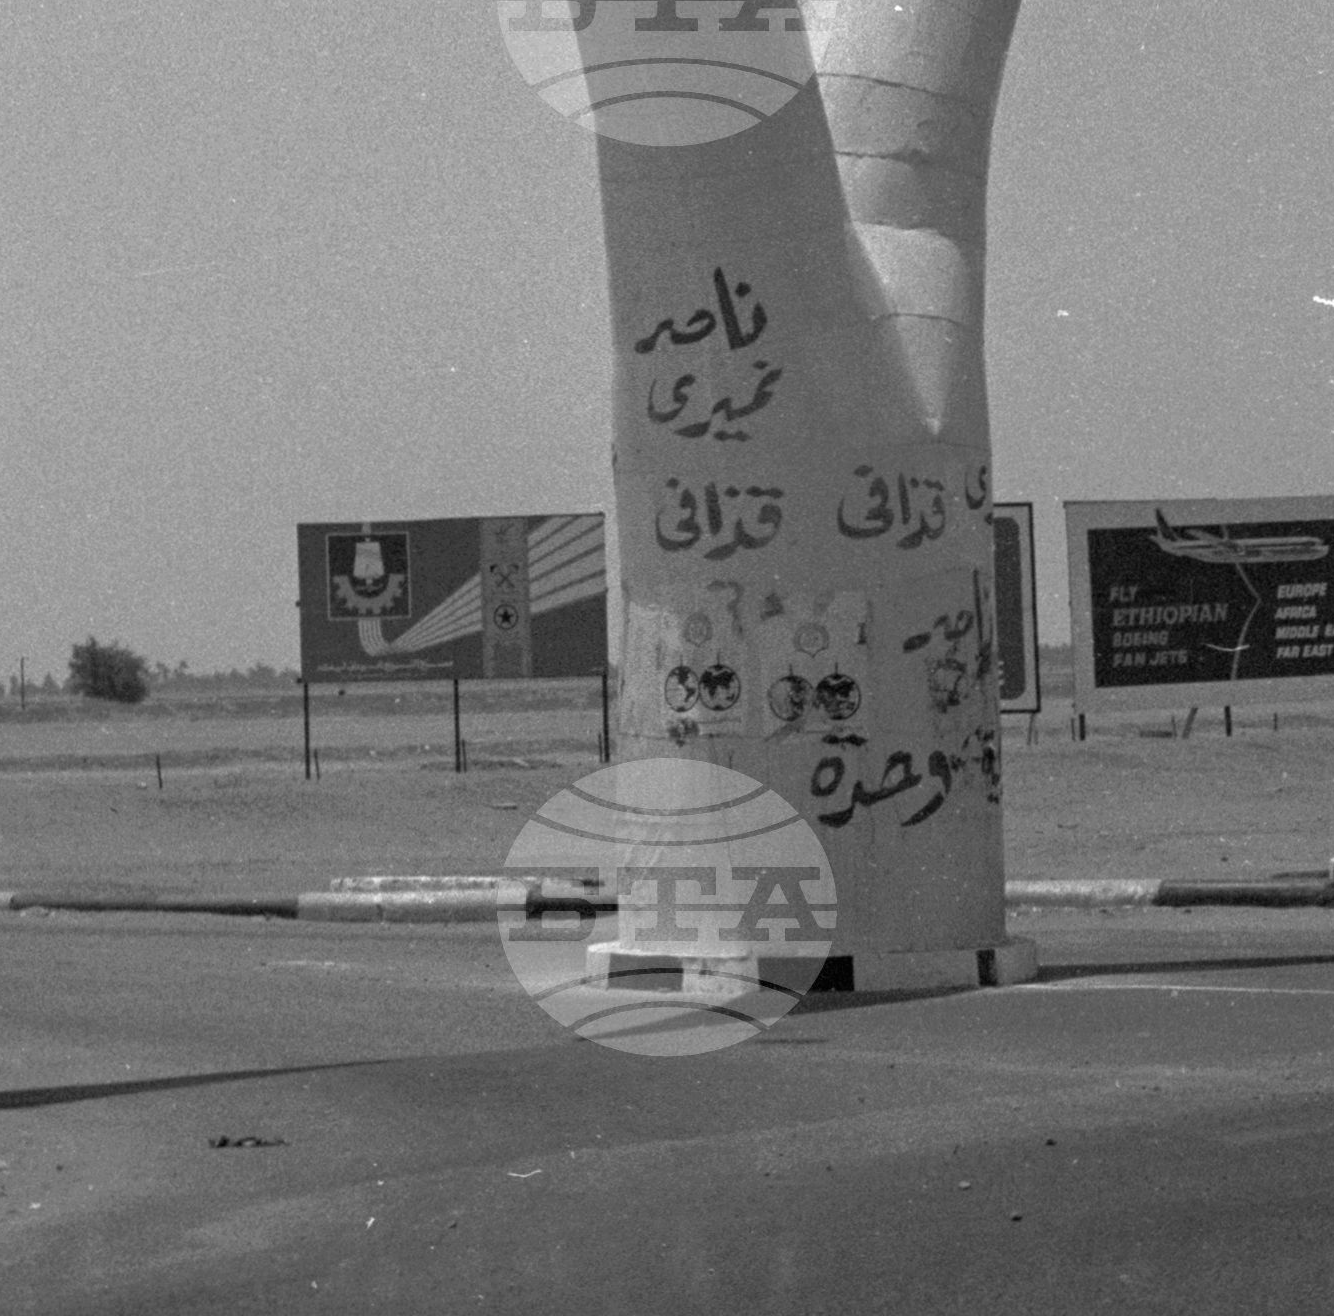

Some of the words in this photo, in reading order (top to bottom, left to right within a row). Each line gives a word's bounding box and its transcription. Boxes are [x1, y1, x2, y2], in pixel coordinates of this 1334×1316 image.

[1109, 586, 1138, 604] FLY
[1276, 582, 1328, 600] EUROPE
[1112, 603, 1229, 627] ETHIOPIAN
[1274, 605, 1317, 620] AFRICA
[1112, 630, 1169, 648] BOEING
[1275, 624, 1320, 640] MIDDLE
[1113, 652, 1146, 668] FAN
[1149, 650, 1188, 666] JETS
[1276, 645, 1300, 659] FAR
[1302, 643, 1334, 658] EAST
